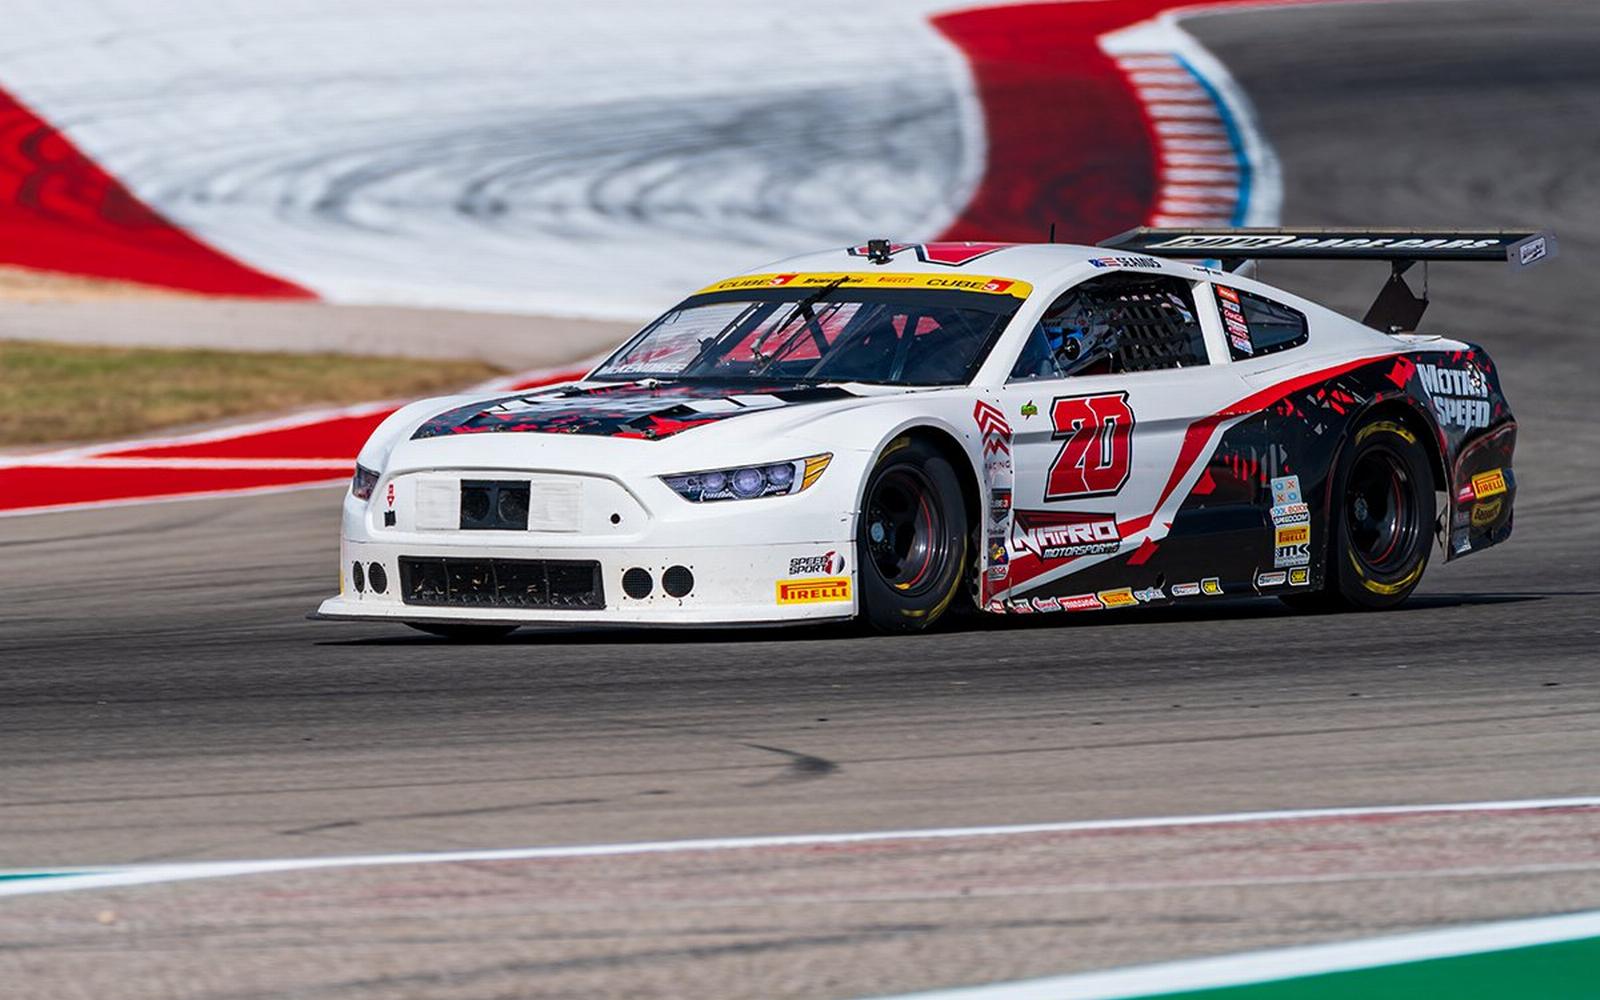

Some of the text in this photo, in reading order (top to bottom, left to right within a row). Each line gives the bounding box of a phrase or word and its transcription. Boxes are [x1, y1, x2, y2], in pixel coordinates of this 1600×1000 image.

[1116, 257, 1162, 268] SEAMUS
[1433, 396, 1490, 434] SPEED
[1043, 390, 1136, 503] 20
[1475, 473, 1504, 495] PIRELLI
[1013, 519, 1120, 558] NITRO
[789, 564, 826, 575] SPORT
[790, 555, 828, 567] SPEED
[780, 581, 847, 600] PIRELLI
